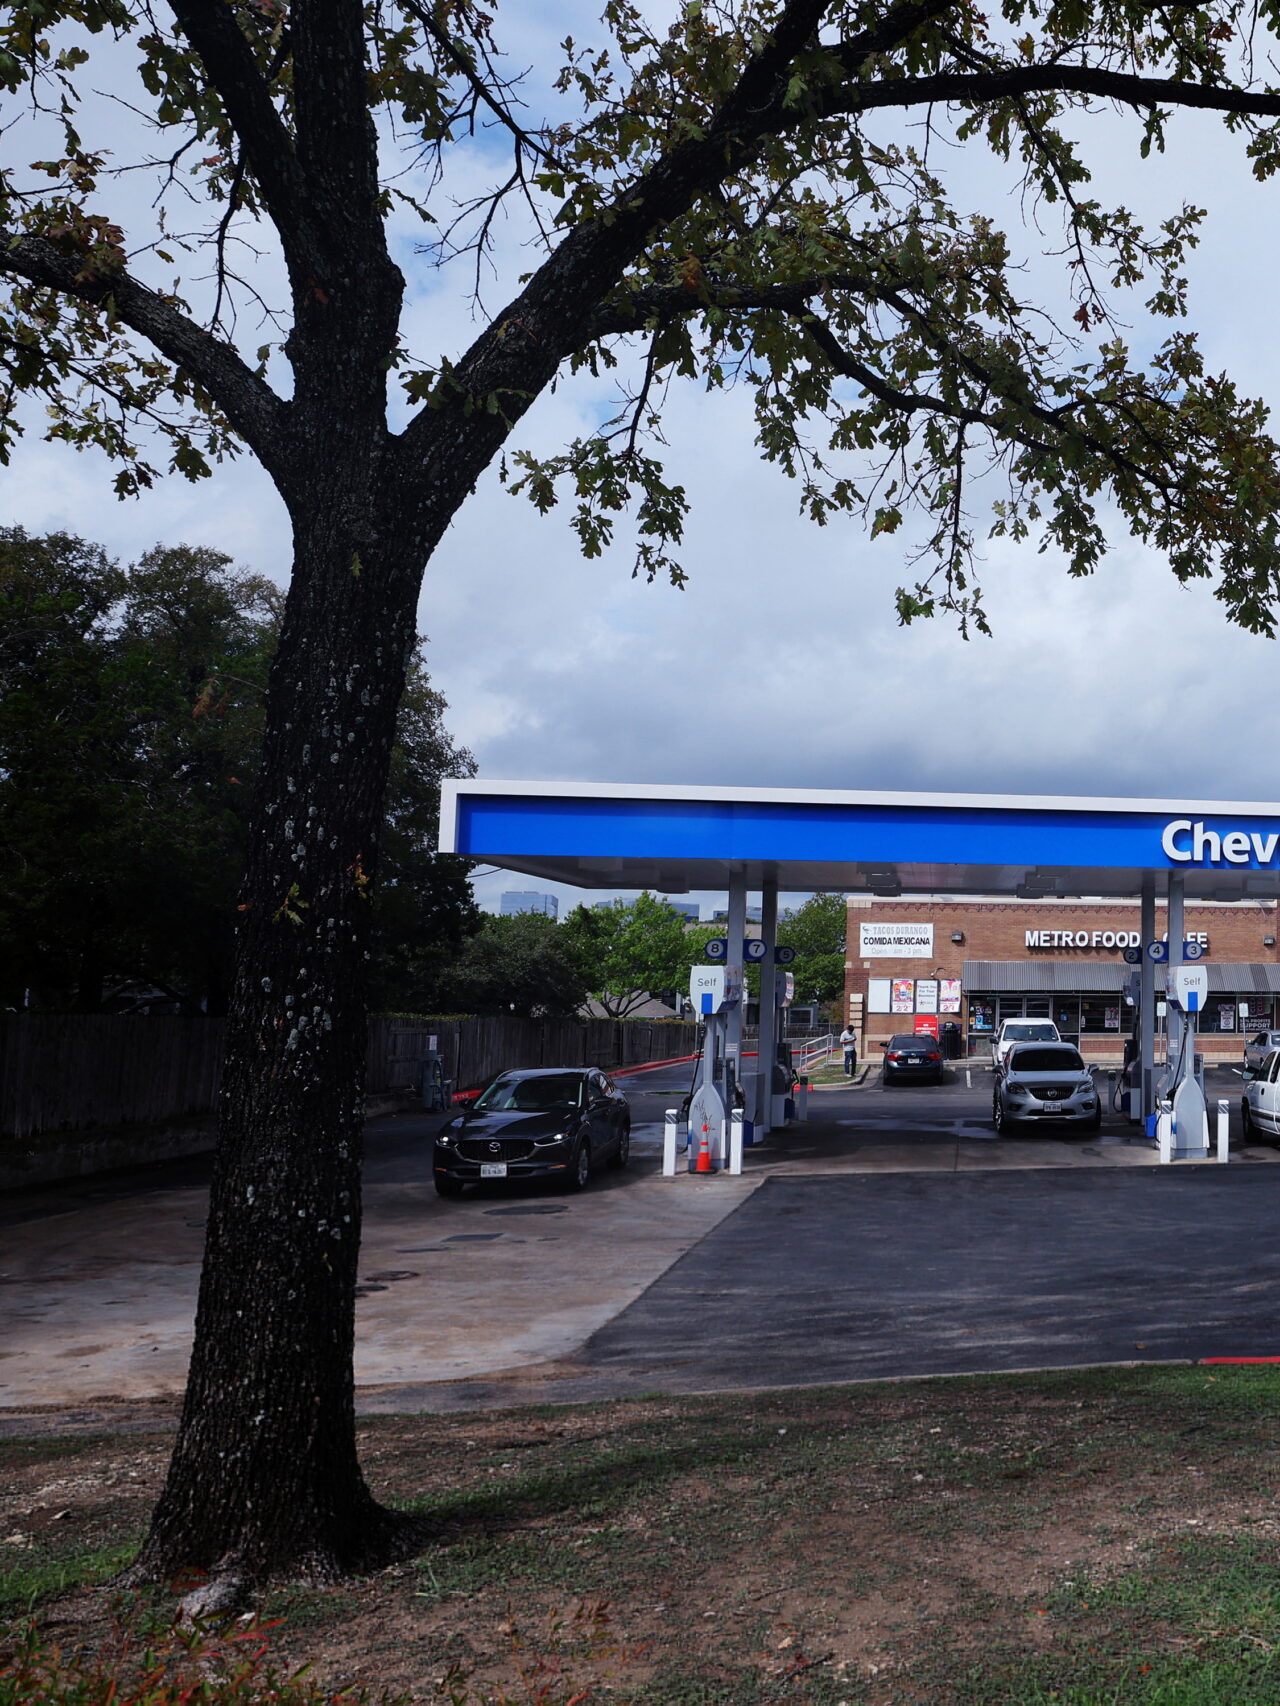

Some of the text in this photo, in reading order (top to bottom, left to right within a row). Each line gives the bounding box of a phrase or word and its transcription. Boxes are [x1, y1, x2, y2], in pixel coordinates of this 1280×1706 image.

[873, 926, 928, 935] TACOS DURANGO
[863, 937, 930, 945] COMIDA MEXICANA
[1025, 930, 1089, 947] METRO
[1092, 931, 1141, 948] FOOD
[697, 978, 717, 987] Self
[1184, 977, 1201, 986] Self
